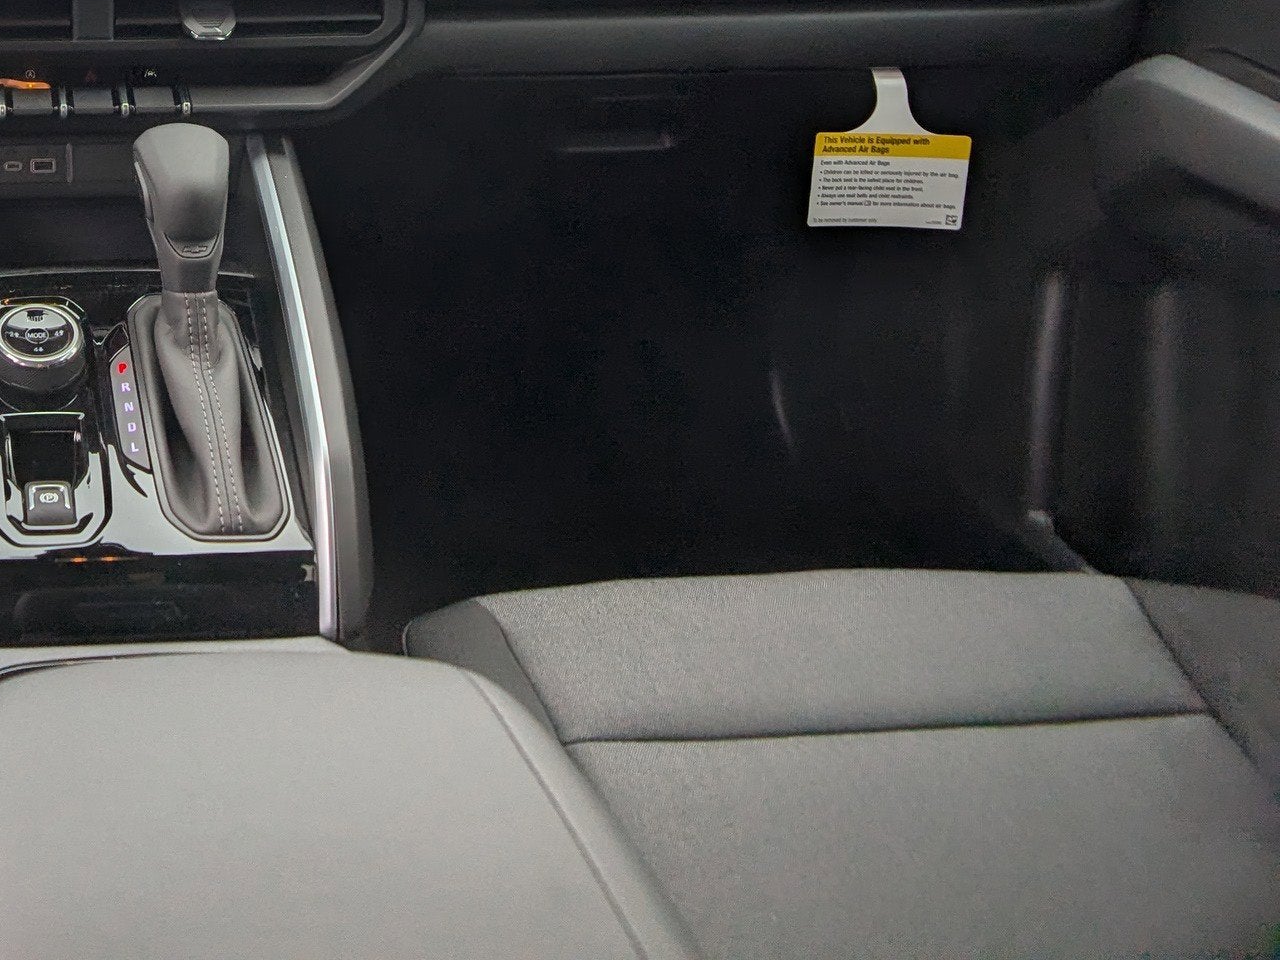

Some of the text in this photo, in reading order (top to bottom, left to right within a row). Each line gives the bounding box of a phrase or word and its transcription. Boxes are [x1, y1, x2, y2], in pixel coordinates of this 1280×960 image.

[876, 137, 910, 145] Equipped
[118, 363, 127, 373] P
[122, 382, 131, 392] R
[124, 402, 134, 412] N
[127, 422, 136, 432] D
[131, 442, 139, 452] L
